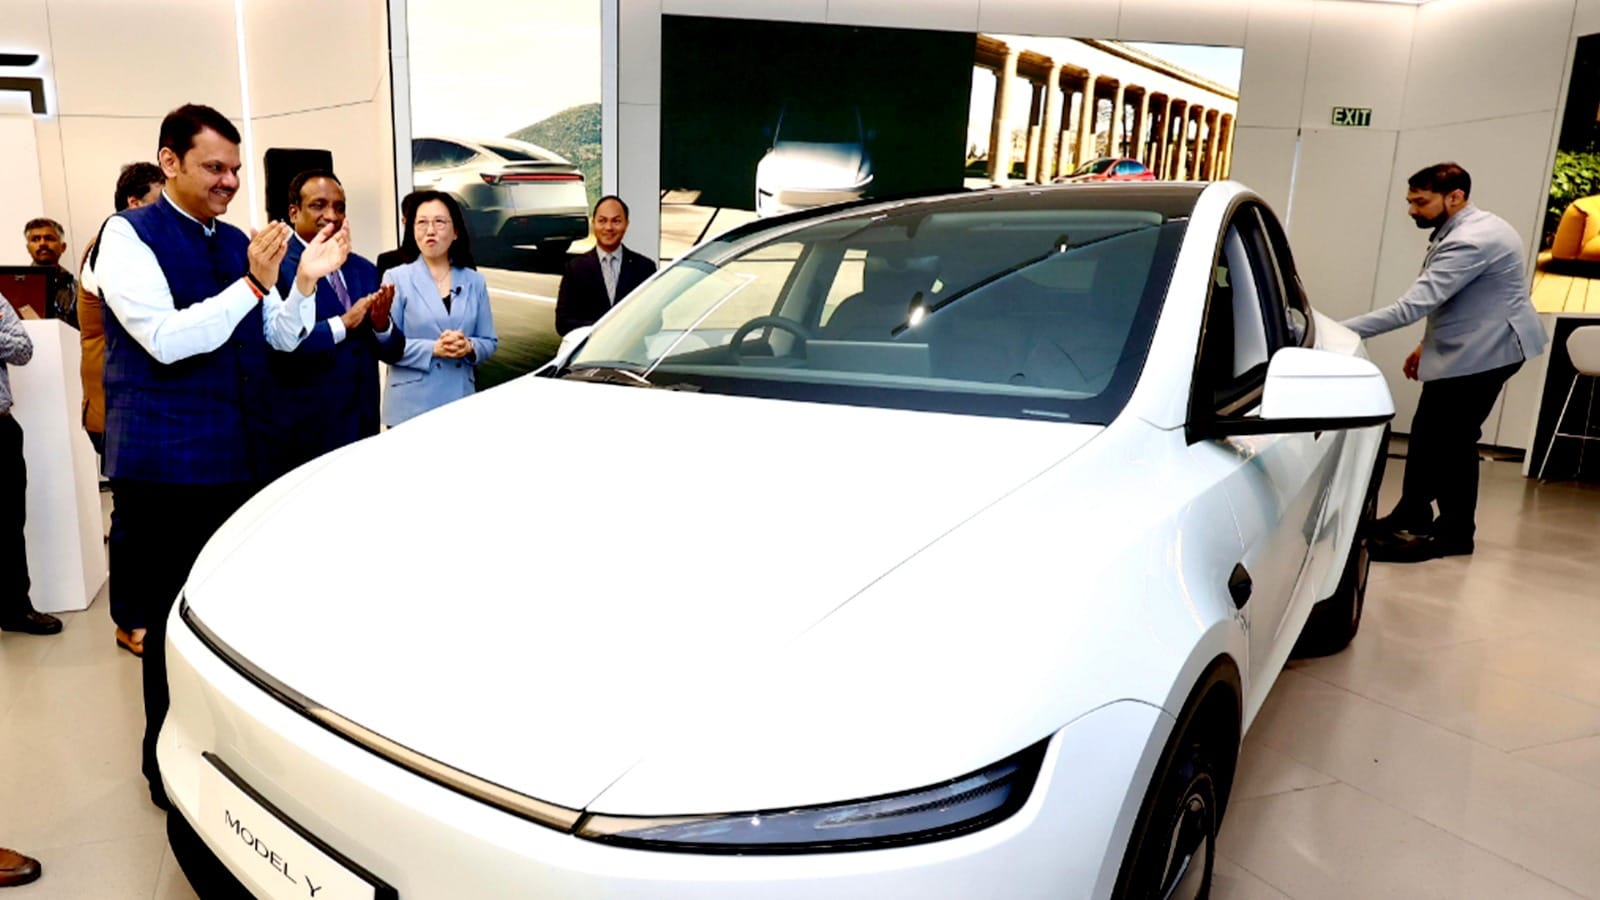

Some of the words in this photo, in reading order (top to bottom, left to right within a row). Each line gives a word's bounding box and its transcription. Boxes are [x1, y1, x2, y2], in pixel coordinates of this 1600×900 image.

[1333, 108, 1370, 125] EXIT
[225, 810, 297, 884] MODEL
[305, 875, 322, 897] Y
